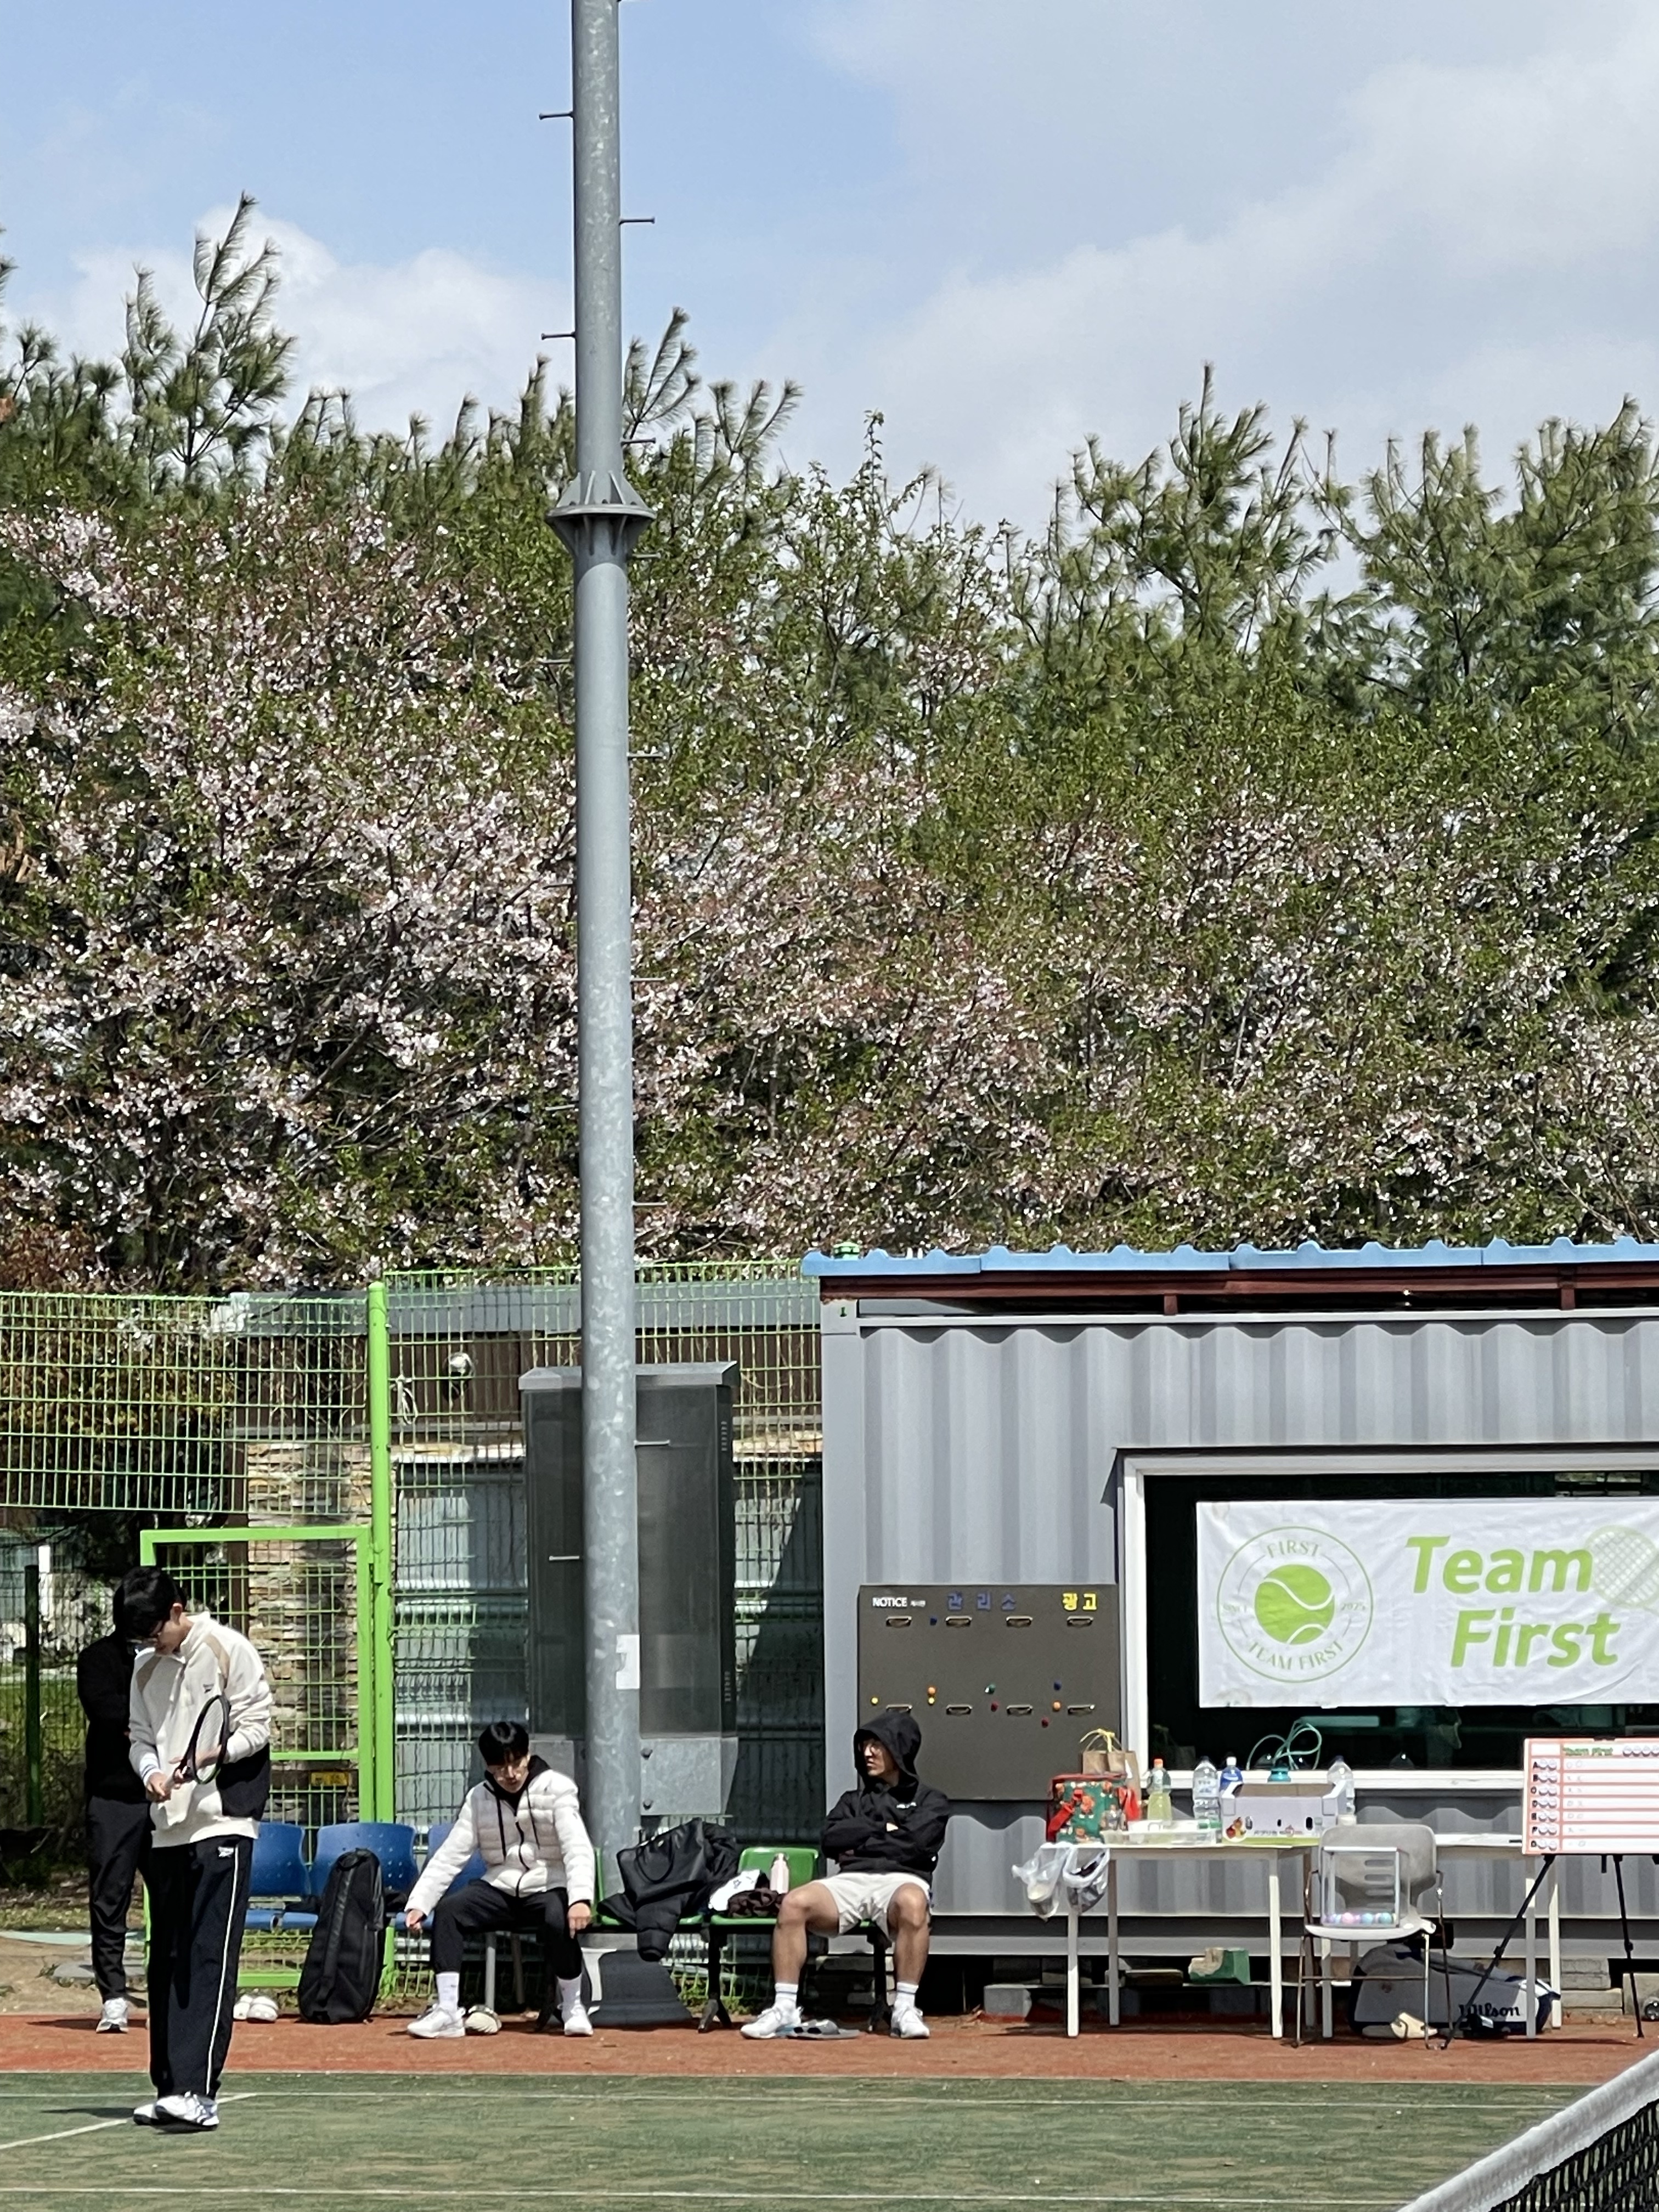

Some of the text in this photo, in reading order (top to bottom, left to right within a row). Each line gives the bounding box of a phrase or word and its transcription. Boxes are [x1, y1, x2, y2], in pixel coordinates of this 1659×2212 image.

[1266, 1539, 1321, 1559] FIRST
[1406, 1536, 1593, 1594] Team
[872, 1597, 907, 1607] NOTICE
[1062, 1593, 1097, 1611] 광고
[1450, 1607, 1620, 1668] First
[1248, 1639, 1343, 1670] TEAM FIRST
[1458, 2002, 1521, 2017] Wilson
